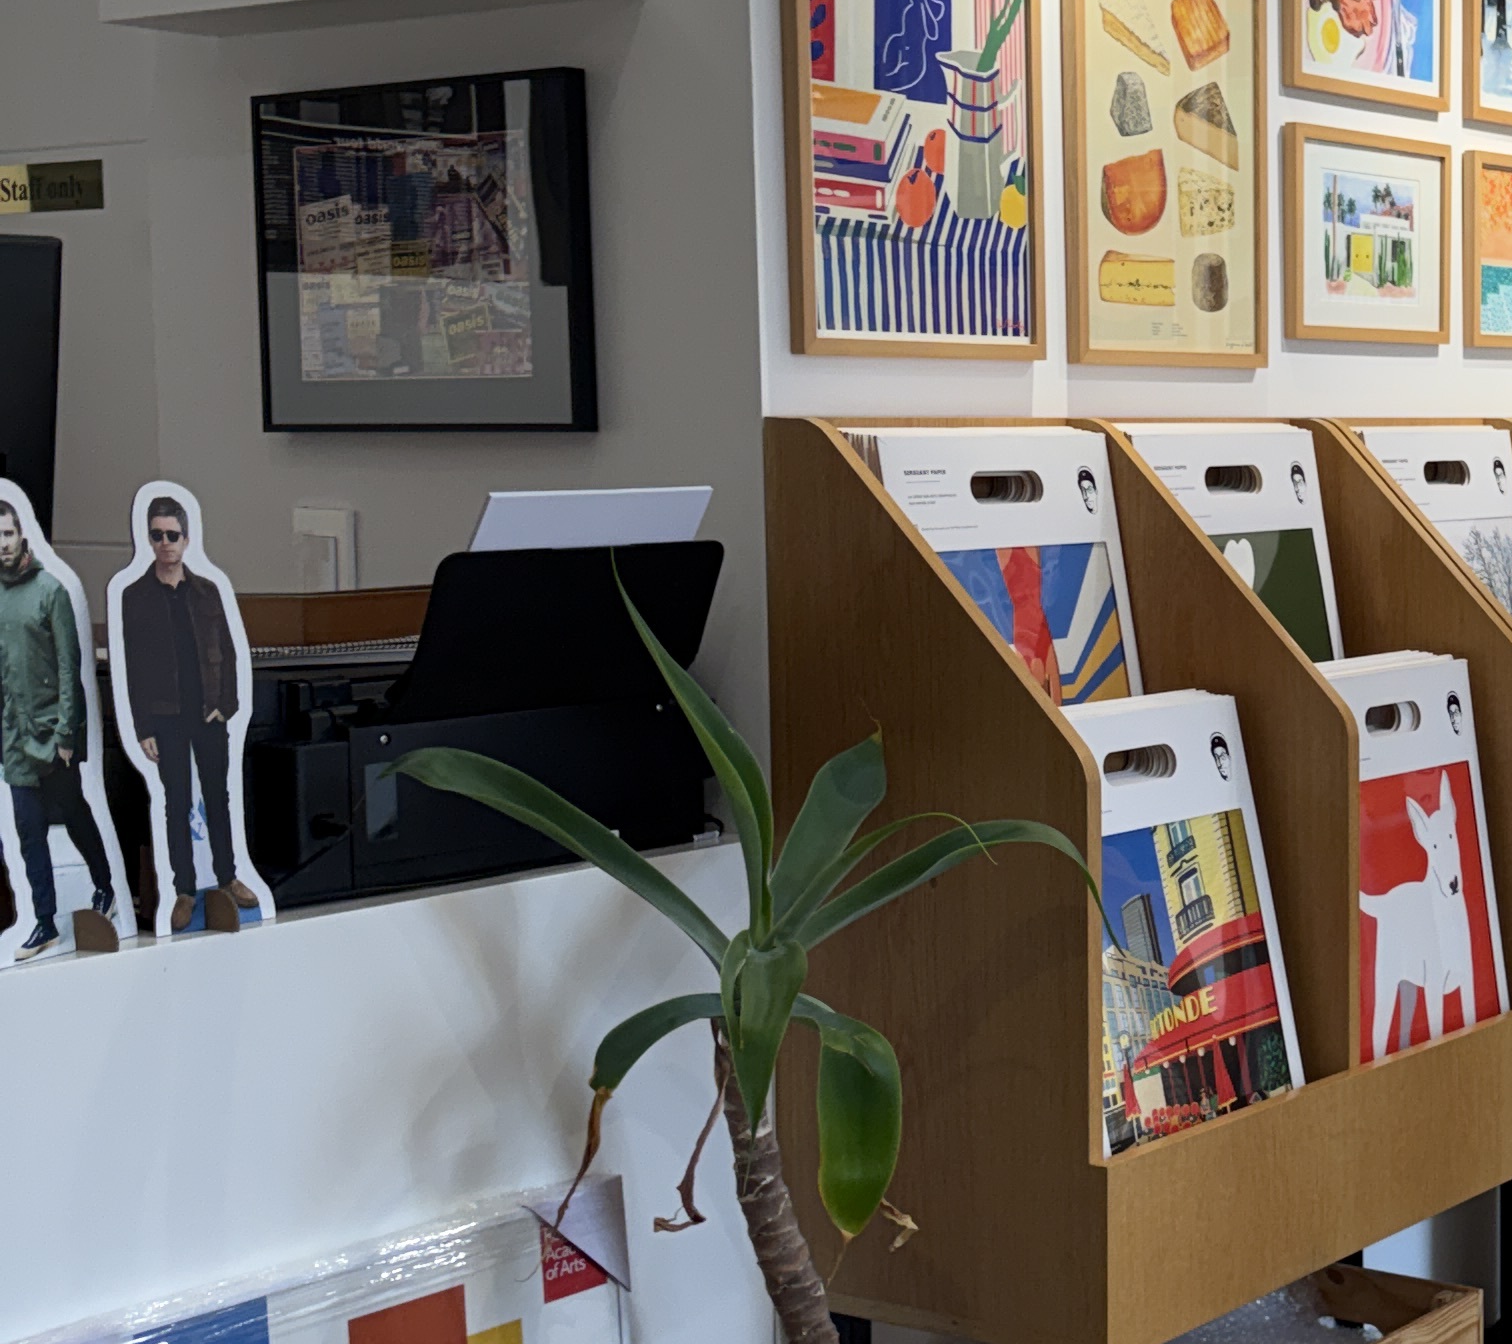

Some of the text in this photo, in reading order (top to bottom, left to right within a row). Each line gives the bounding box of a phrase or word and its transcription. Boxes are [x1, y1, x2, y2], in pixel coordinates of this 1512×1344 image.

[305, 206, 350, 226] oasis
[545, 1257, 587, 1281] of Arts
